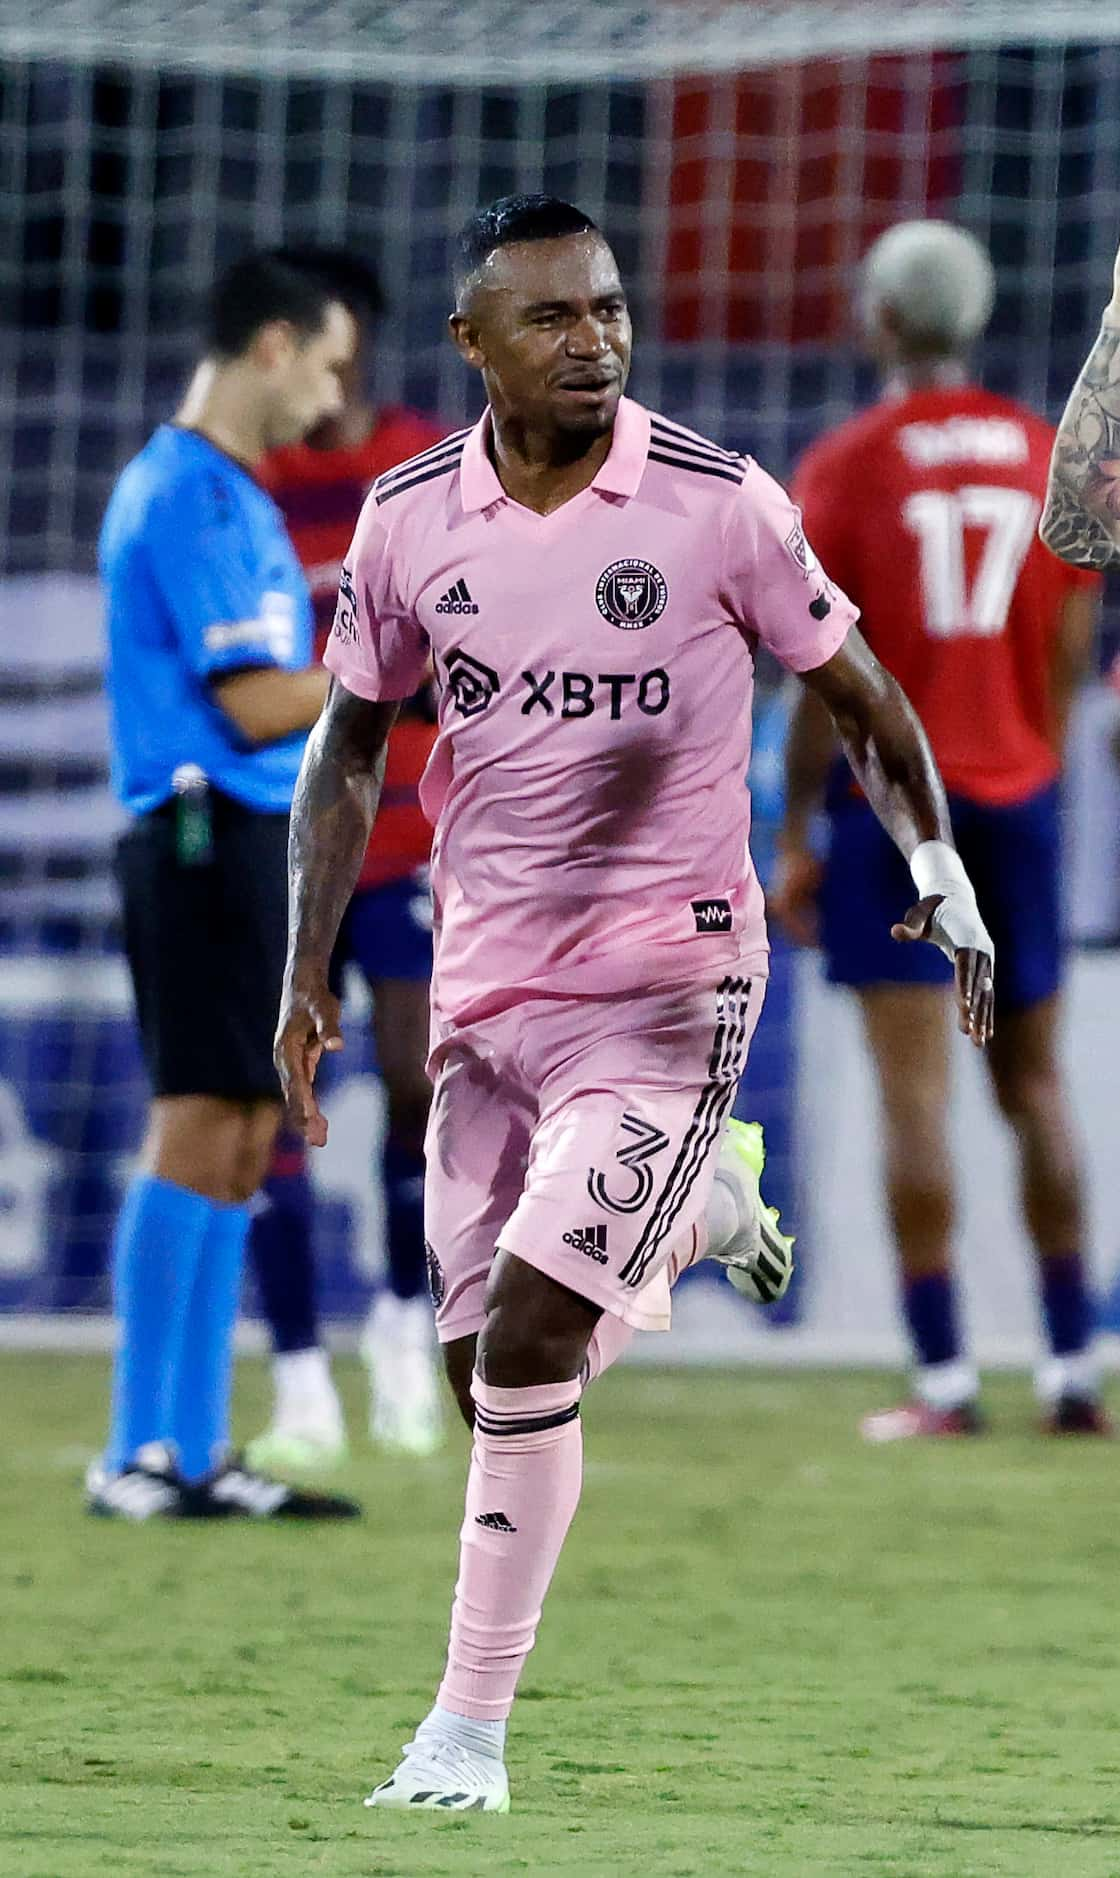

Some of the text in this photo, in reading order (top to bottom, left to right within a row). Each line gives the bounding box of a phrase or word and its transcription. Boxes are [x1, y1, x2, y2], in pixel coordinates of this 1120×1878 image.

[903, 487, 1038, 638] 17
[435, 602, 479, 614] adidas
[520, 668, 670, 720] XBTO
[587, 1113, 670, 1216] 3
[562, 1232, 609, 1265] adidas
